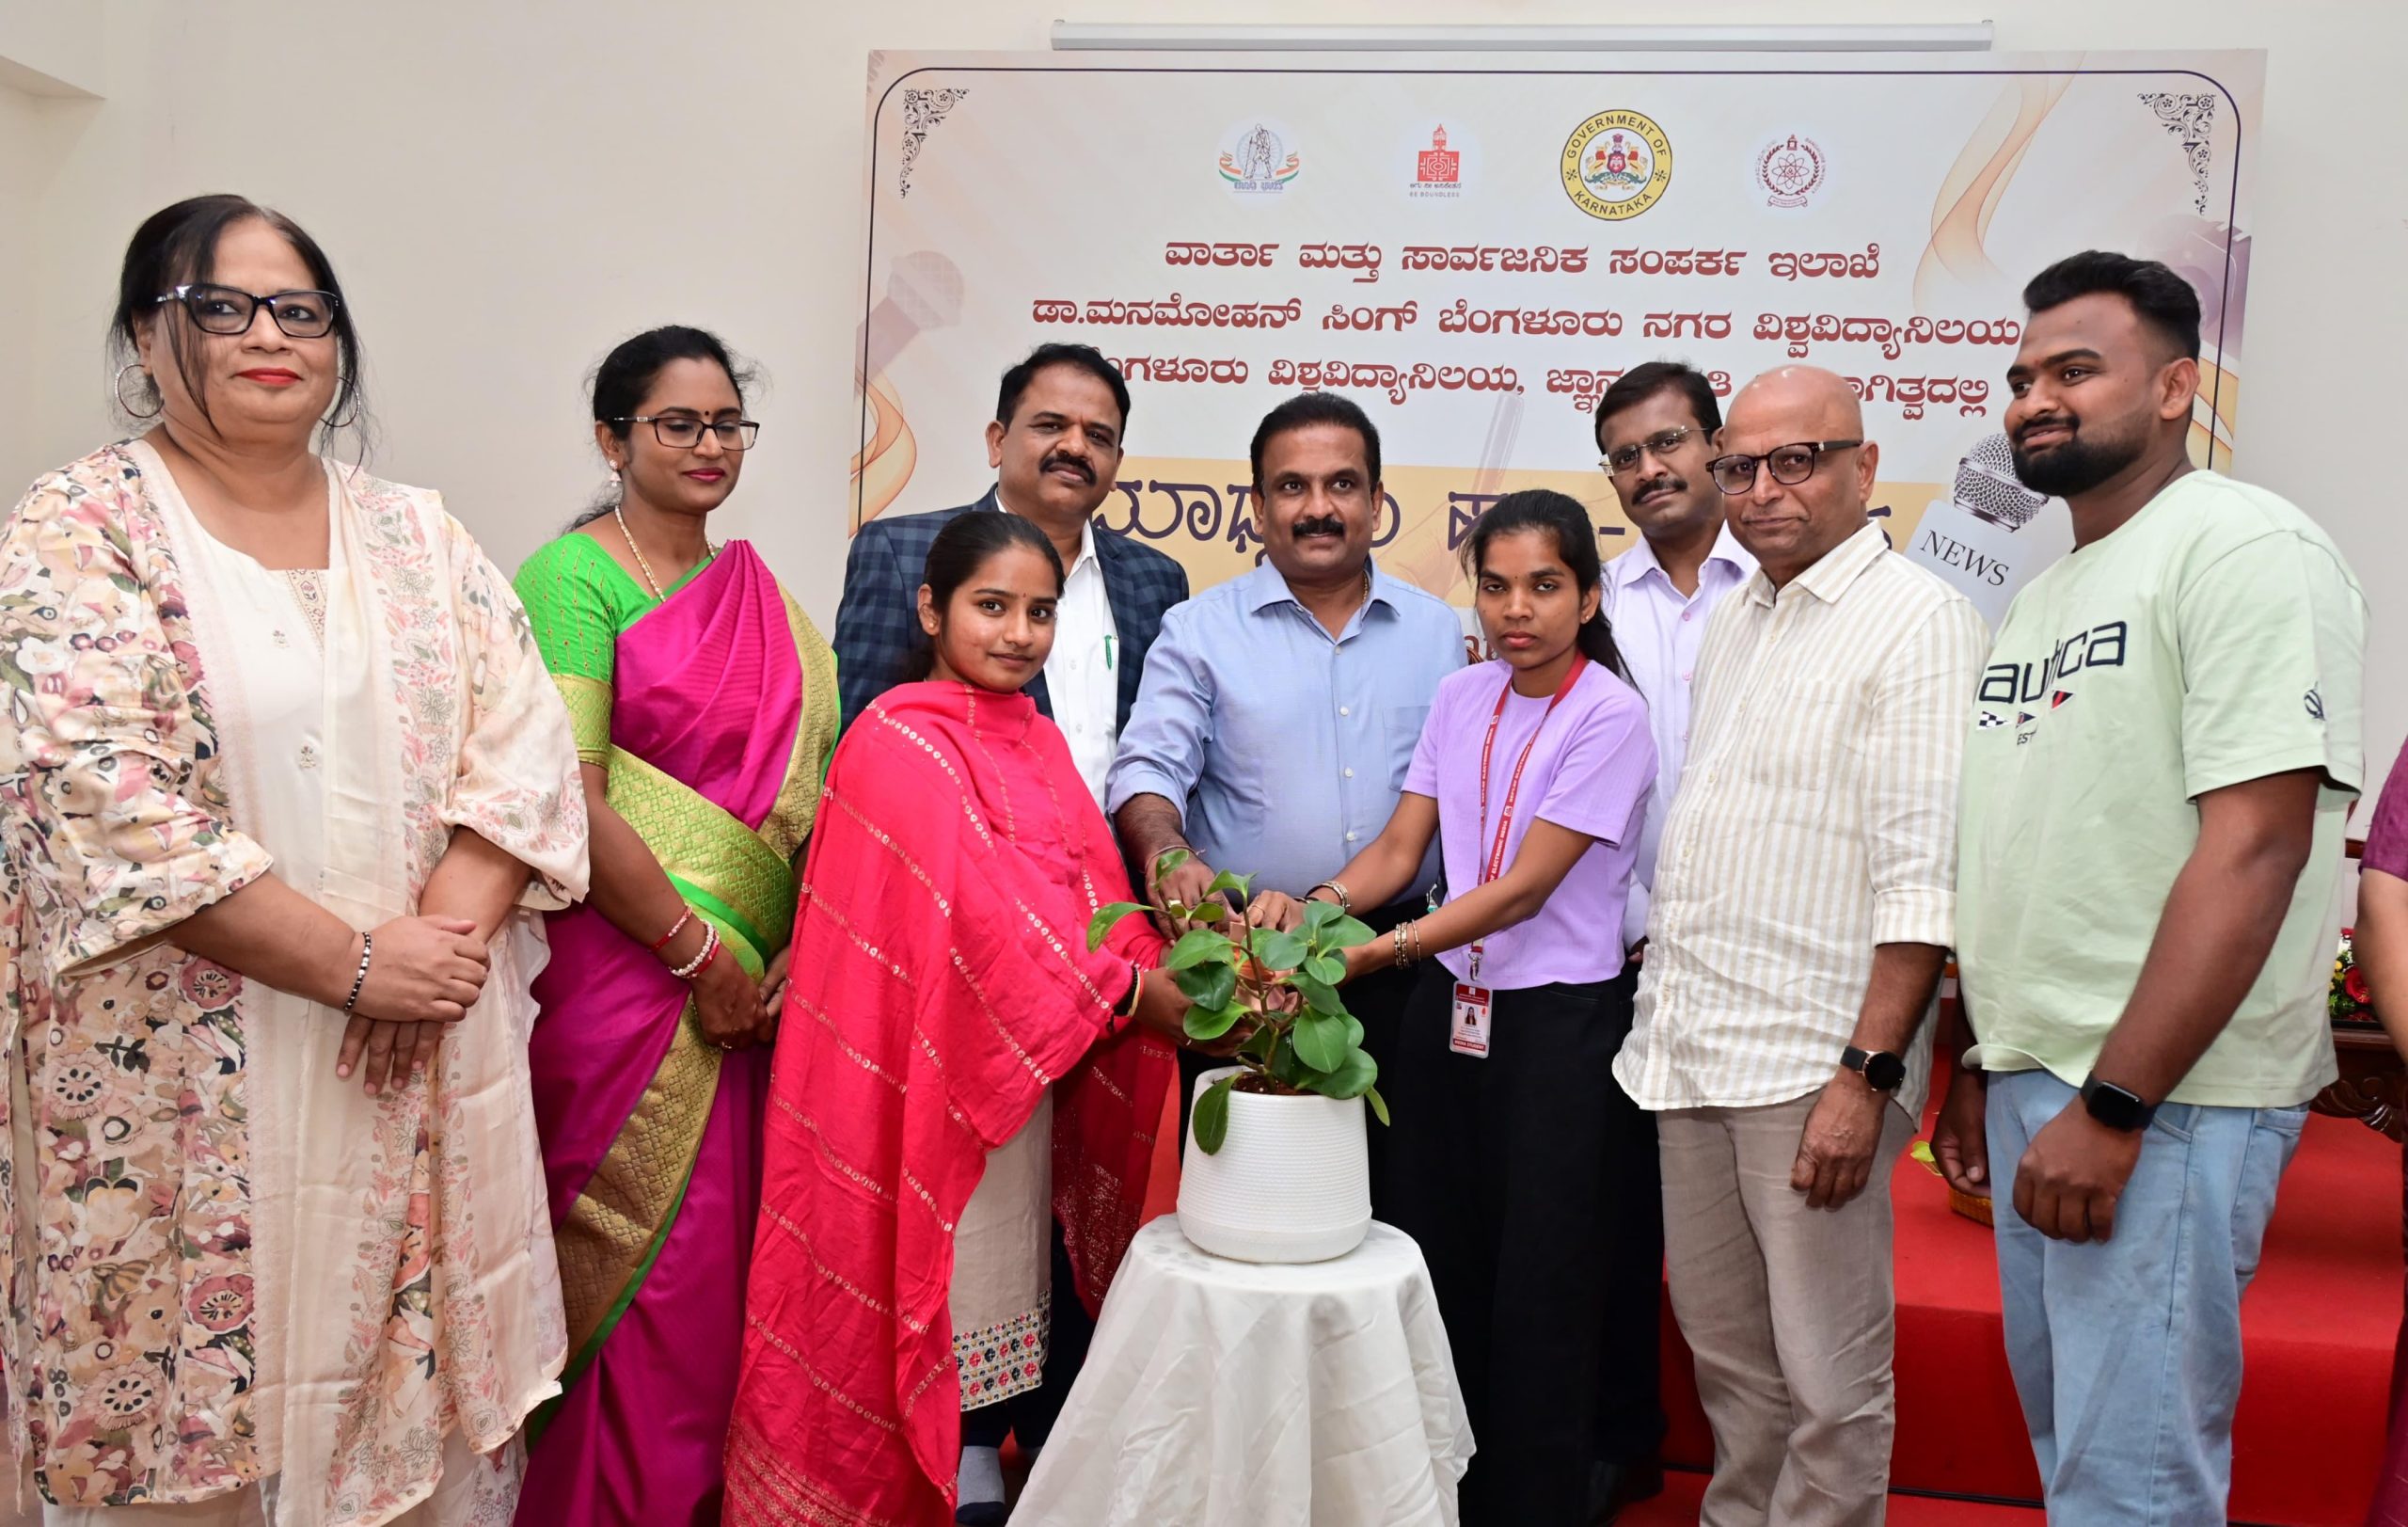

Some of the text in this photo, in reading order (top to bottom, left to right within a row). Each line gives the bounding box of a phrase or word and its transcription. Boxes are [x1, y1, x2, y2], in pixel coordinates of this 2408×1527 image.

[1566, 115, 1667, 159] GOVERNMENT OF
[1574, 190, 1653, 215] KARNATAKA
[1164, 241, 1880, 283] ವಾರ್ತಾ ಮತ್ತು ಸಾರ್ವಜನಿಕ ಸಂಪರ್ಕ ಇಲಾಖೆ
[1032, 293, 2021, 361] ಡಾ.ಮನಮೋಹನ್ ಸಿಂಗ್ ಬೆಂಗಳೂರು ನಗರ ವಿಶ್ವವಿದ್ಯಾನಿಲಯ
[1093, 346, 1249, 385] ಂಗಳೂರು
[1920, 529, 2010, 586] NEWS
[1491, 839, 1504, 875] ELECTRONIC
